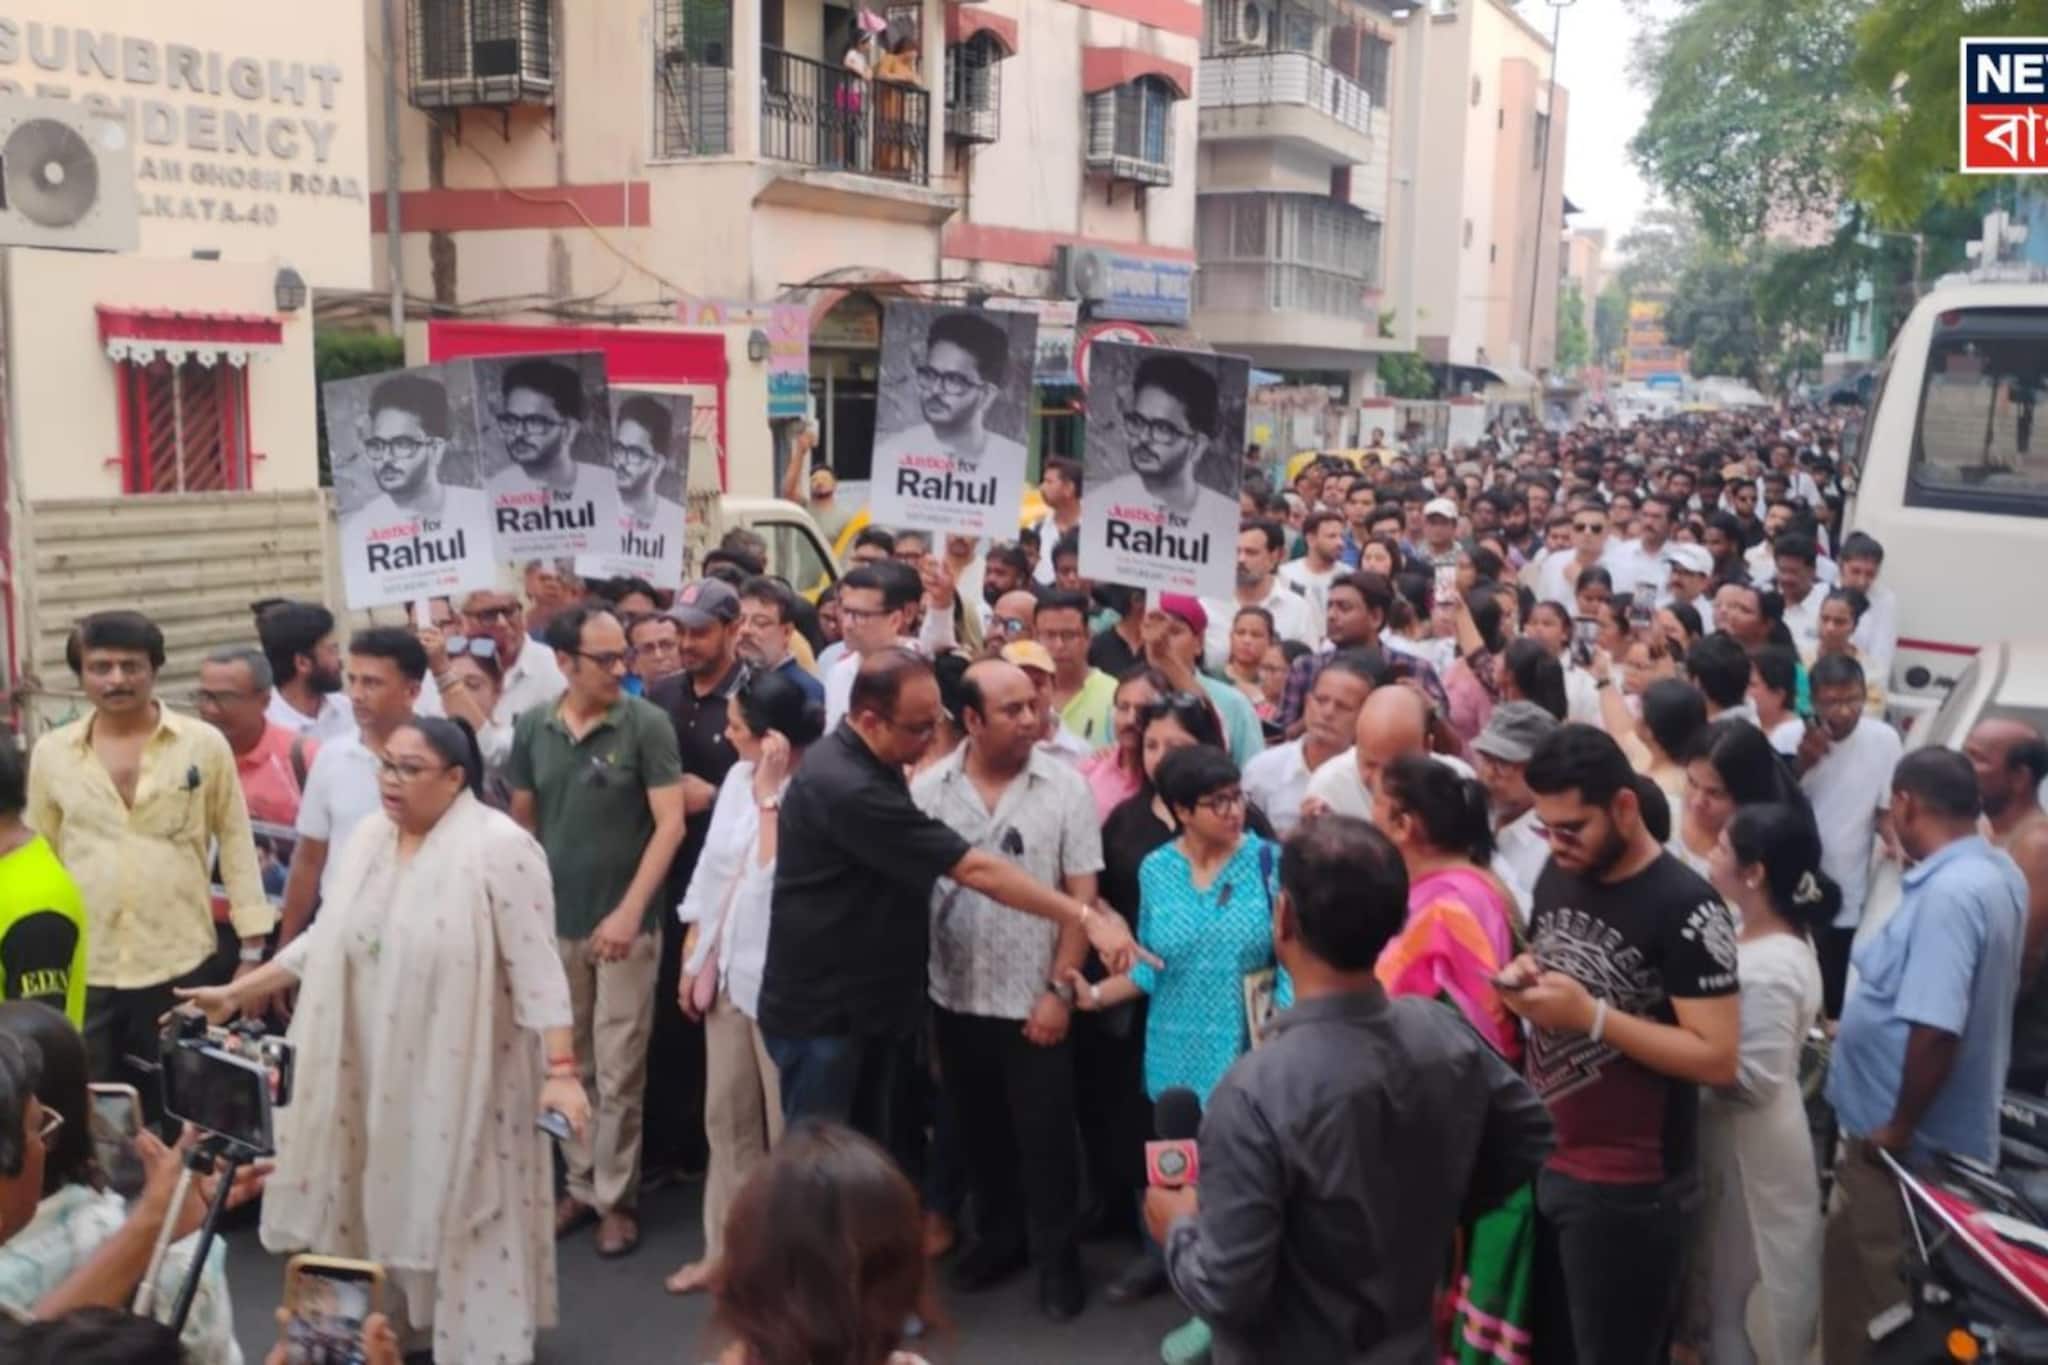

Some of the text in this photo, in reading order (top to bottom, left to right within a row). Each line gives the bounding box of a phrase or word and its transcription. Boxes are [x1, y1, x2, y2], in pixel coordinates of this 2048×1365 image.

[0, 16, 343, 110] SUNBRIGHT
[957, 459, 978, 473] for
[553, 488, 574, 501] for
[896, 467, 997, 507] Rahul
[422, 518, 442, 533] for
[496, 501, 596, 534] Rahul
[1168, 512, 1190, 528] for
[366, 528, 467, 573] Rahul
[621, 529, 665, 560] hul
[1105, 518, 1210, 564] Rahul
